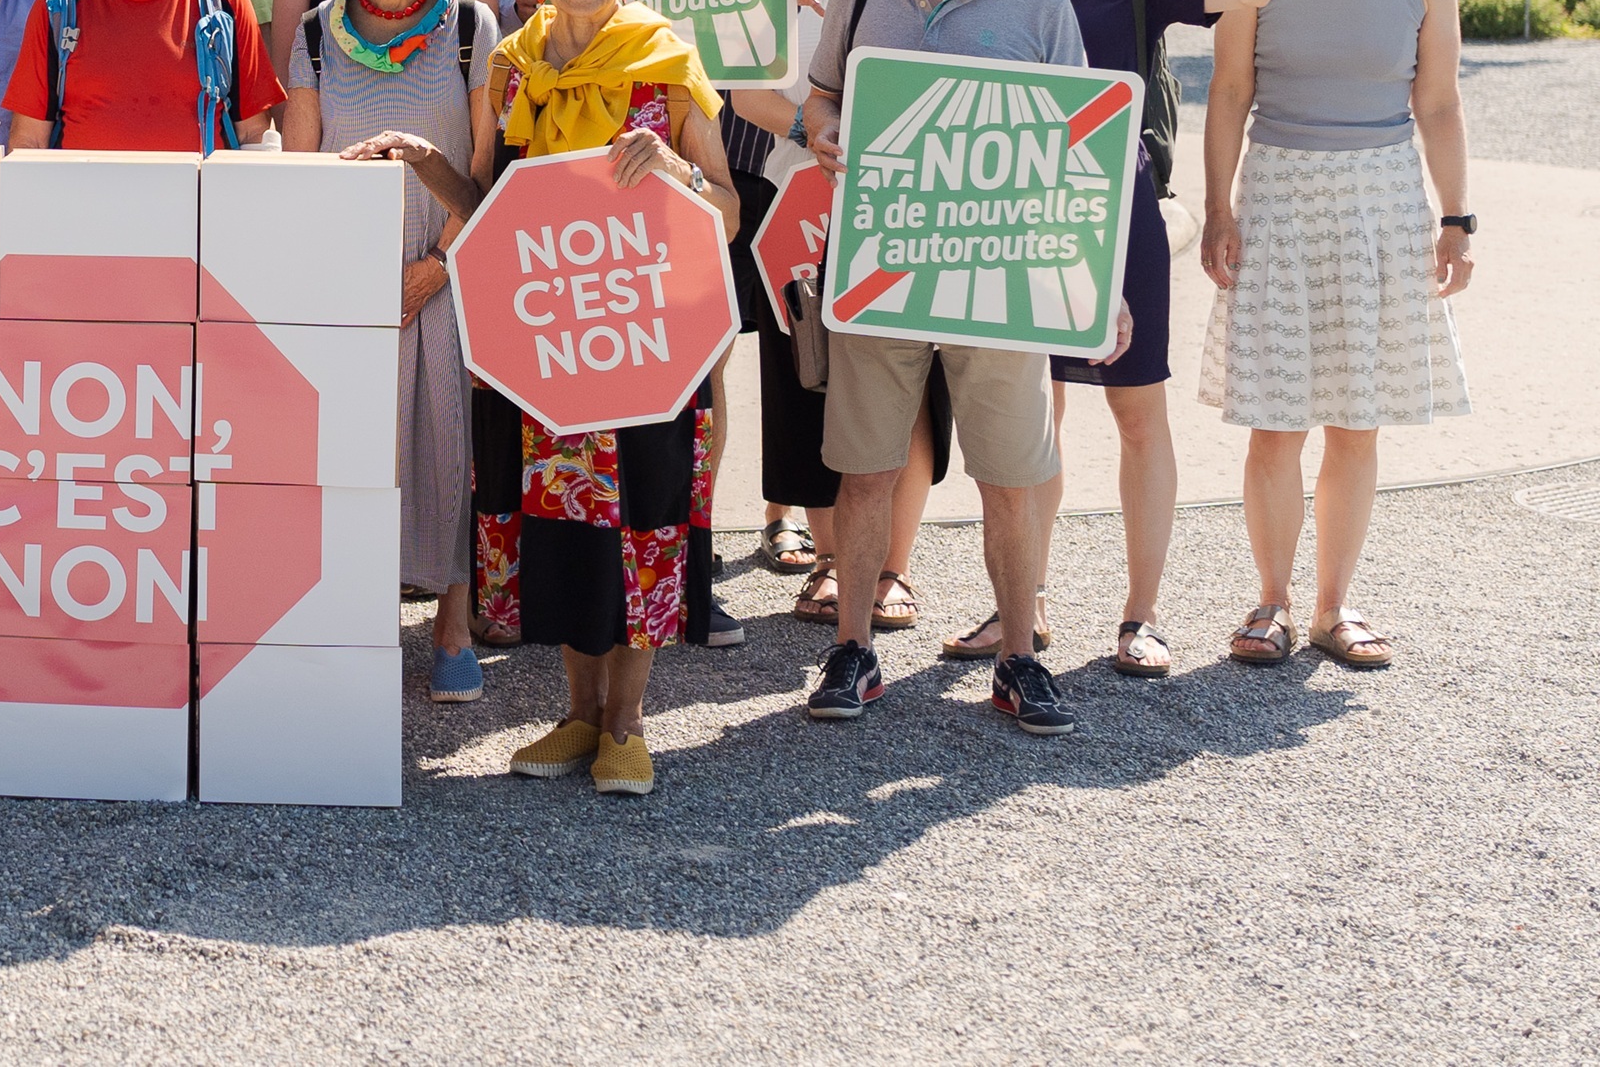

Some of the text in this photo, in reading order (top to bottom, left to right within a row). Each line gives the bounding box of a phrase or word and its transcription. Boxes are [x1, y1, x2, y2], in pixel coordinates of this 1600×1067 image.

[919, 129, 1063, 191] NON
[853, 189, 1107, 230] à de nouvelles
[515, 212, 668, 274] NON,
[884, 230, 1078, 265] autoroutes
[513, 262, 672, 327] C'EST
[534, 317, 670, 379] NON
